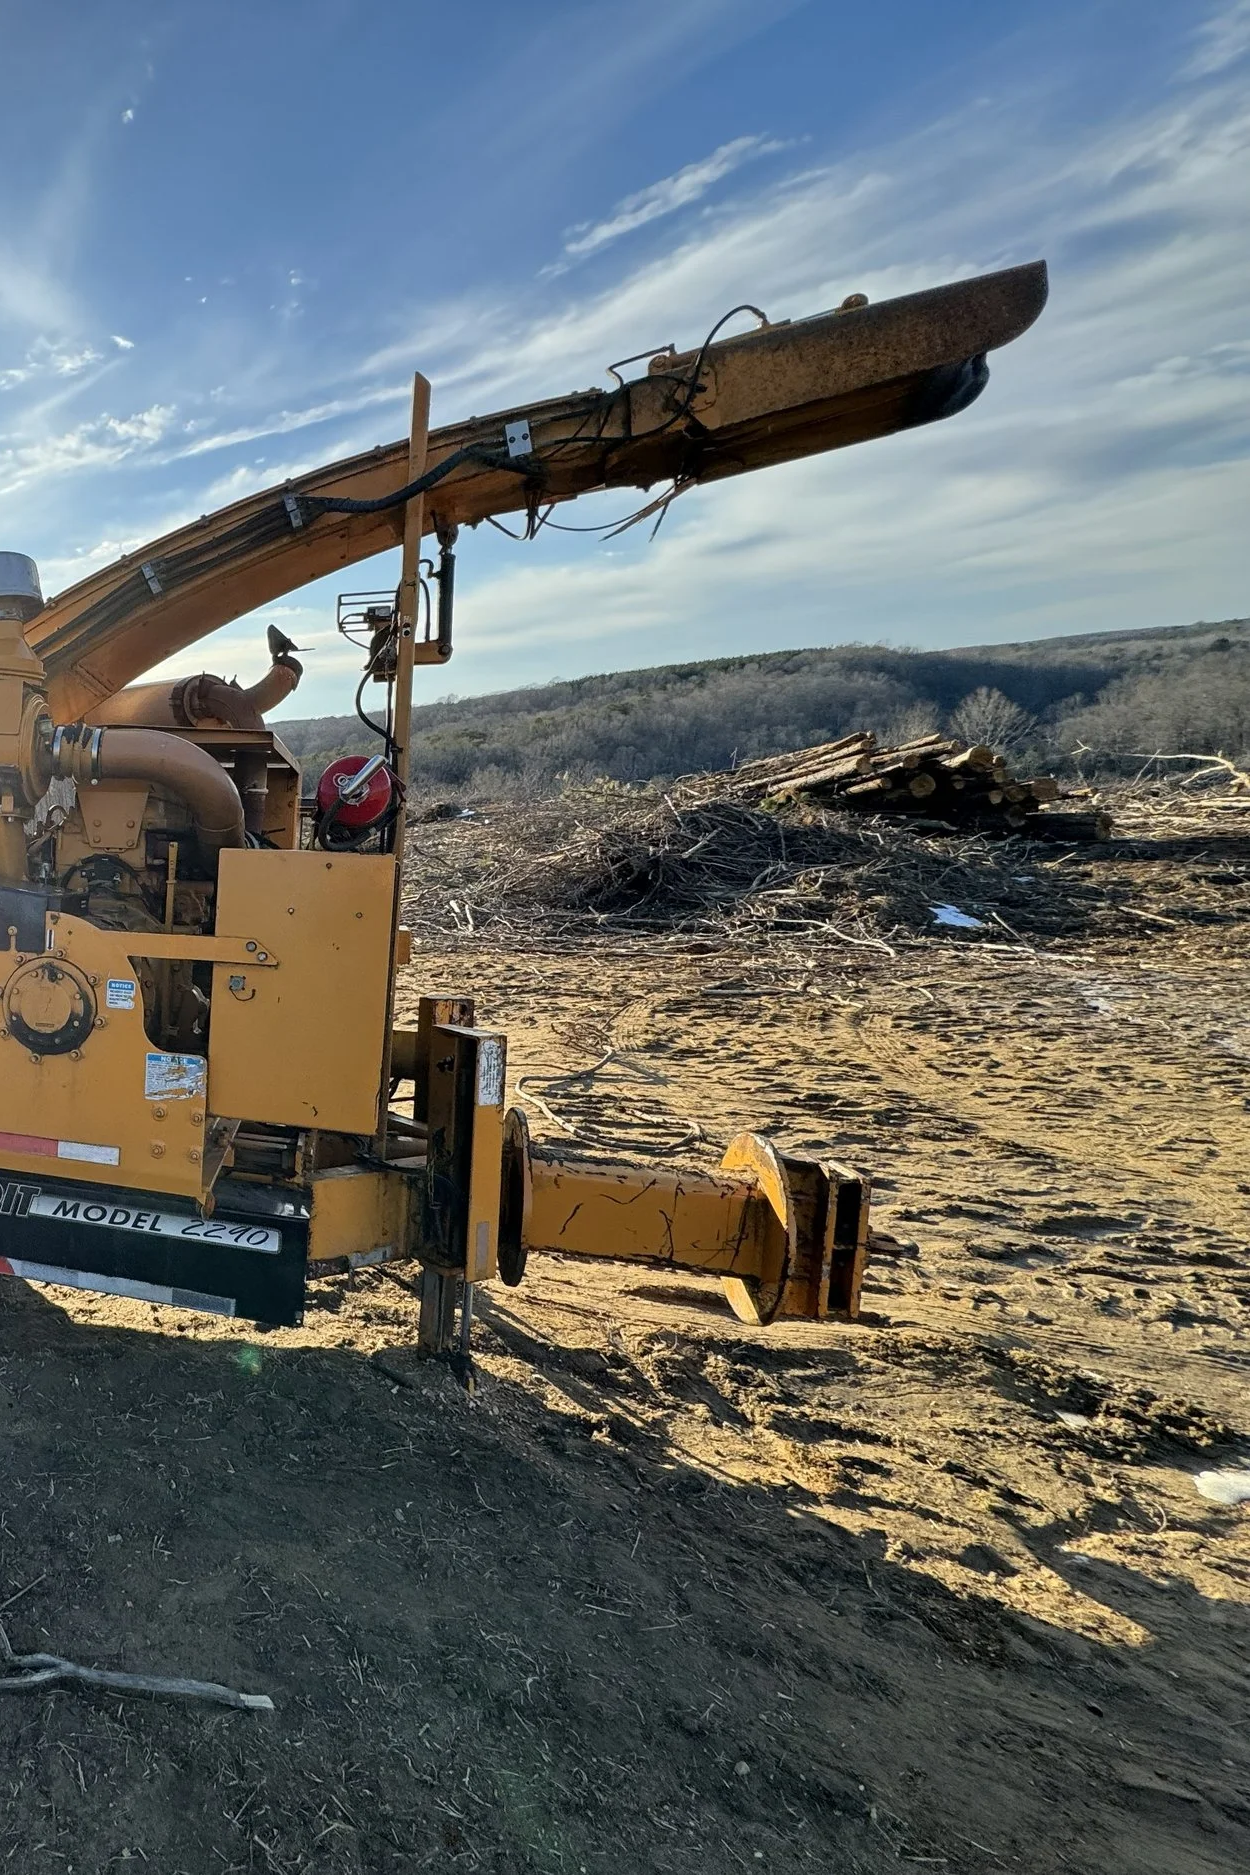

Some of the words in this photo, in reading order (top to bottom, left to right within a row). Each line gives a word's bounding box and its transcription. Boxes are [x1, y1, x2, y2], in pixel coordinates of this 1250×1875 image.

[160, 1056, 188, 1064] NOICE
[52, 1200, 162, 1232] MODEL
[181, 1219, 270, 1246] 2290
